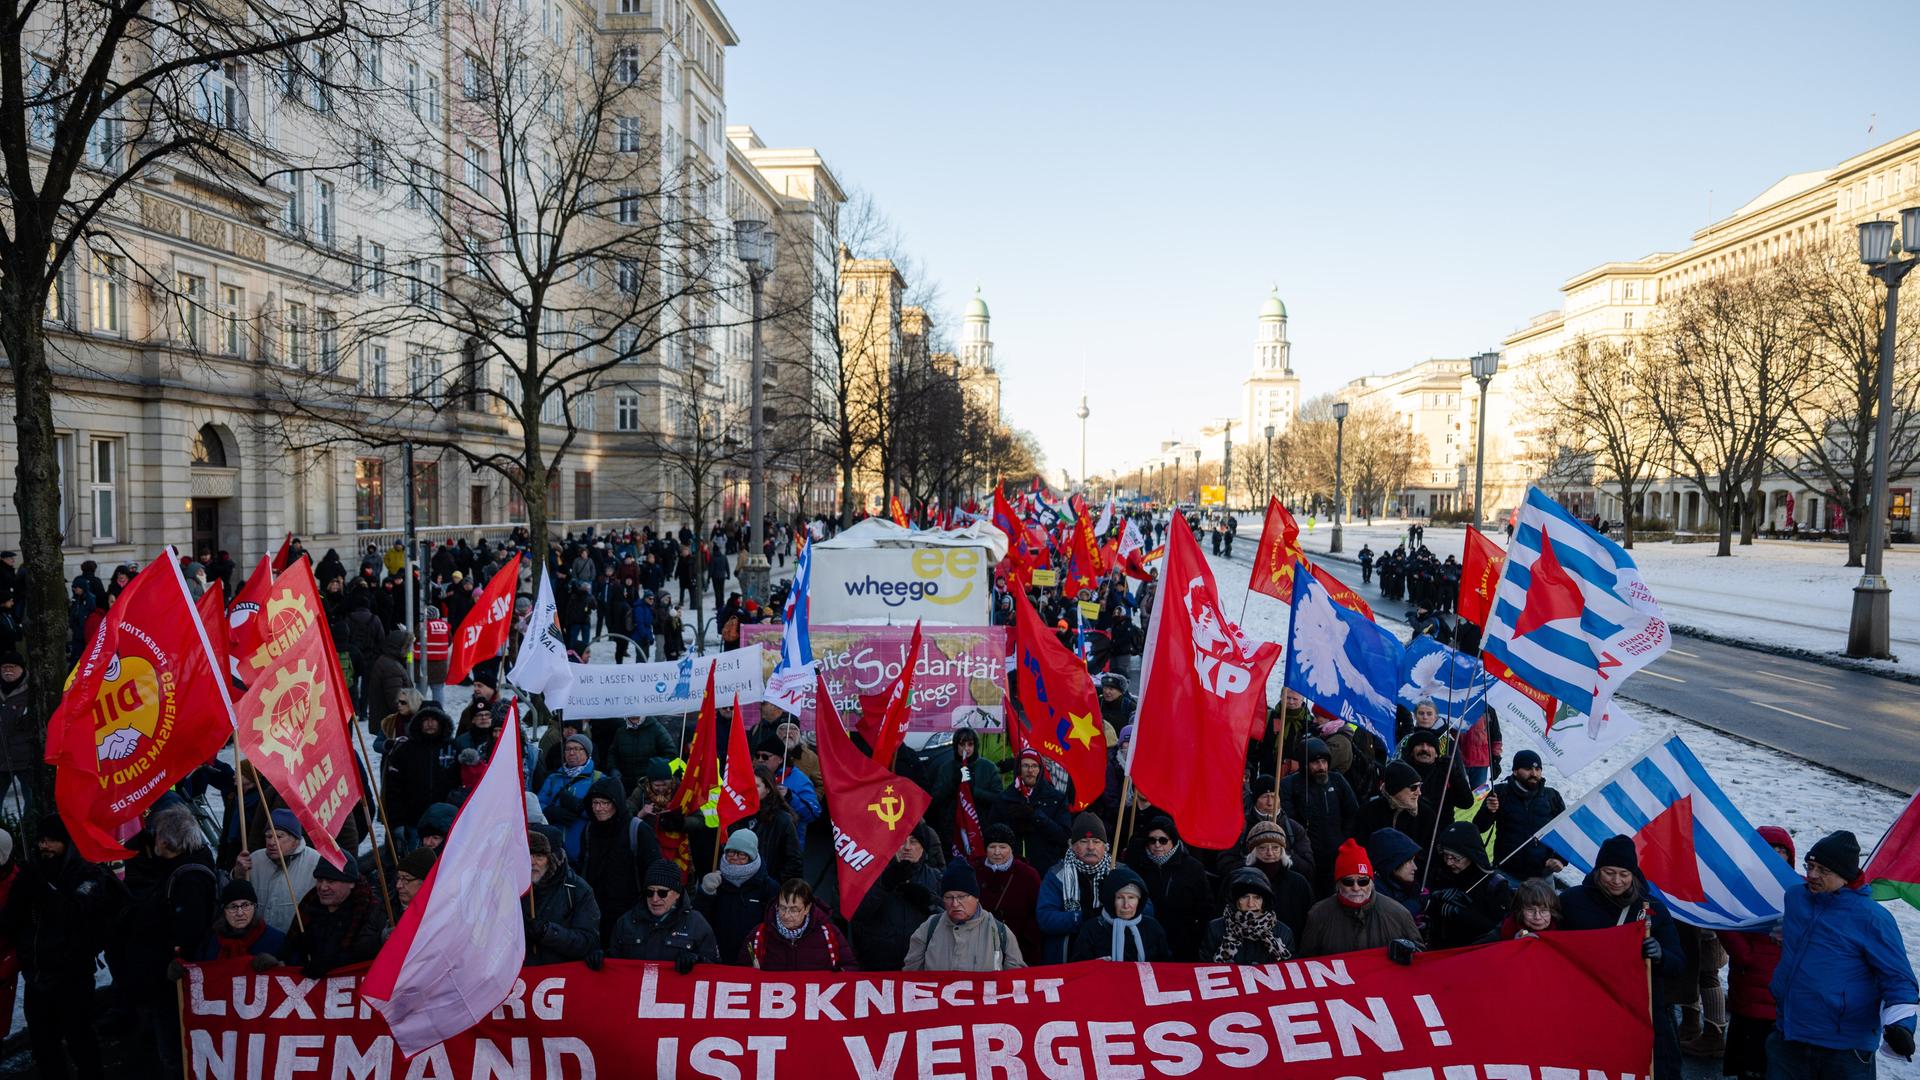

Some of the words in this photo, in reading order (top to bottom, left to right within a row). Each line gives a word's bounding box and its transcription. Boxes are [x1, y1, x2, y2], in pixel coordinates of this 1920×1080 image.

[845, 575, 939, 601] wheego
[579, 675, 594, 685] WIR
[600, 674, 634, 685] LASSEN
[640, 672, 658, 683] UNS
[853, 643, 1002, 689] Soldarität
[567, 695, 600, 706] SCHLUSS
[604, 696, 620, 705] MIT
[624, 696, 640, 705] DEN
[186, 962, 566, 1020] LUXERG
[638, 961, 1065, 1021] LIEBKNECHT
[1137, 959, 1355, 1006] LENIN
[189, 1028, 599, 1080] NIEMAND
[653, 1036, 787, 1080] IST
